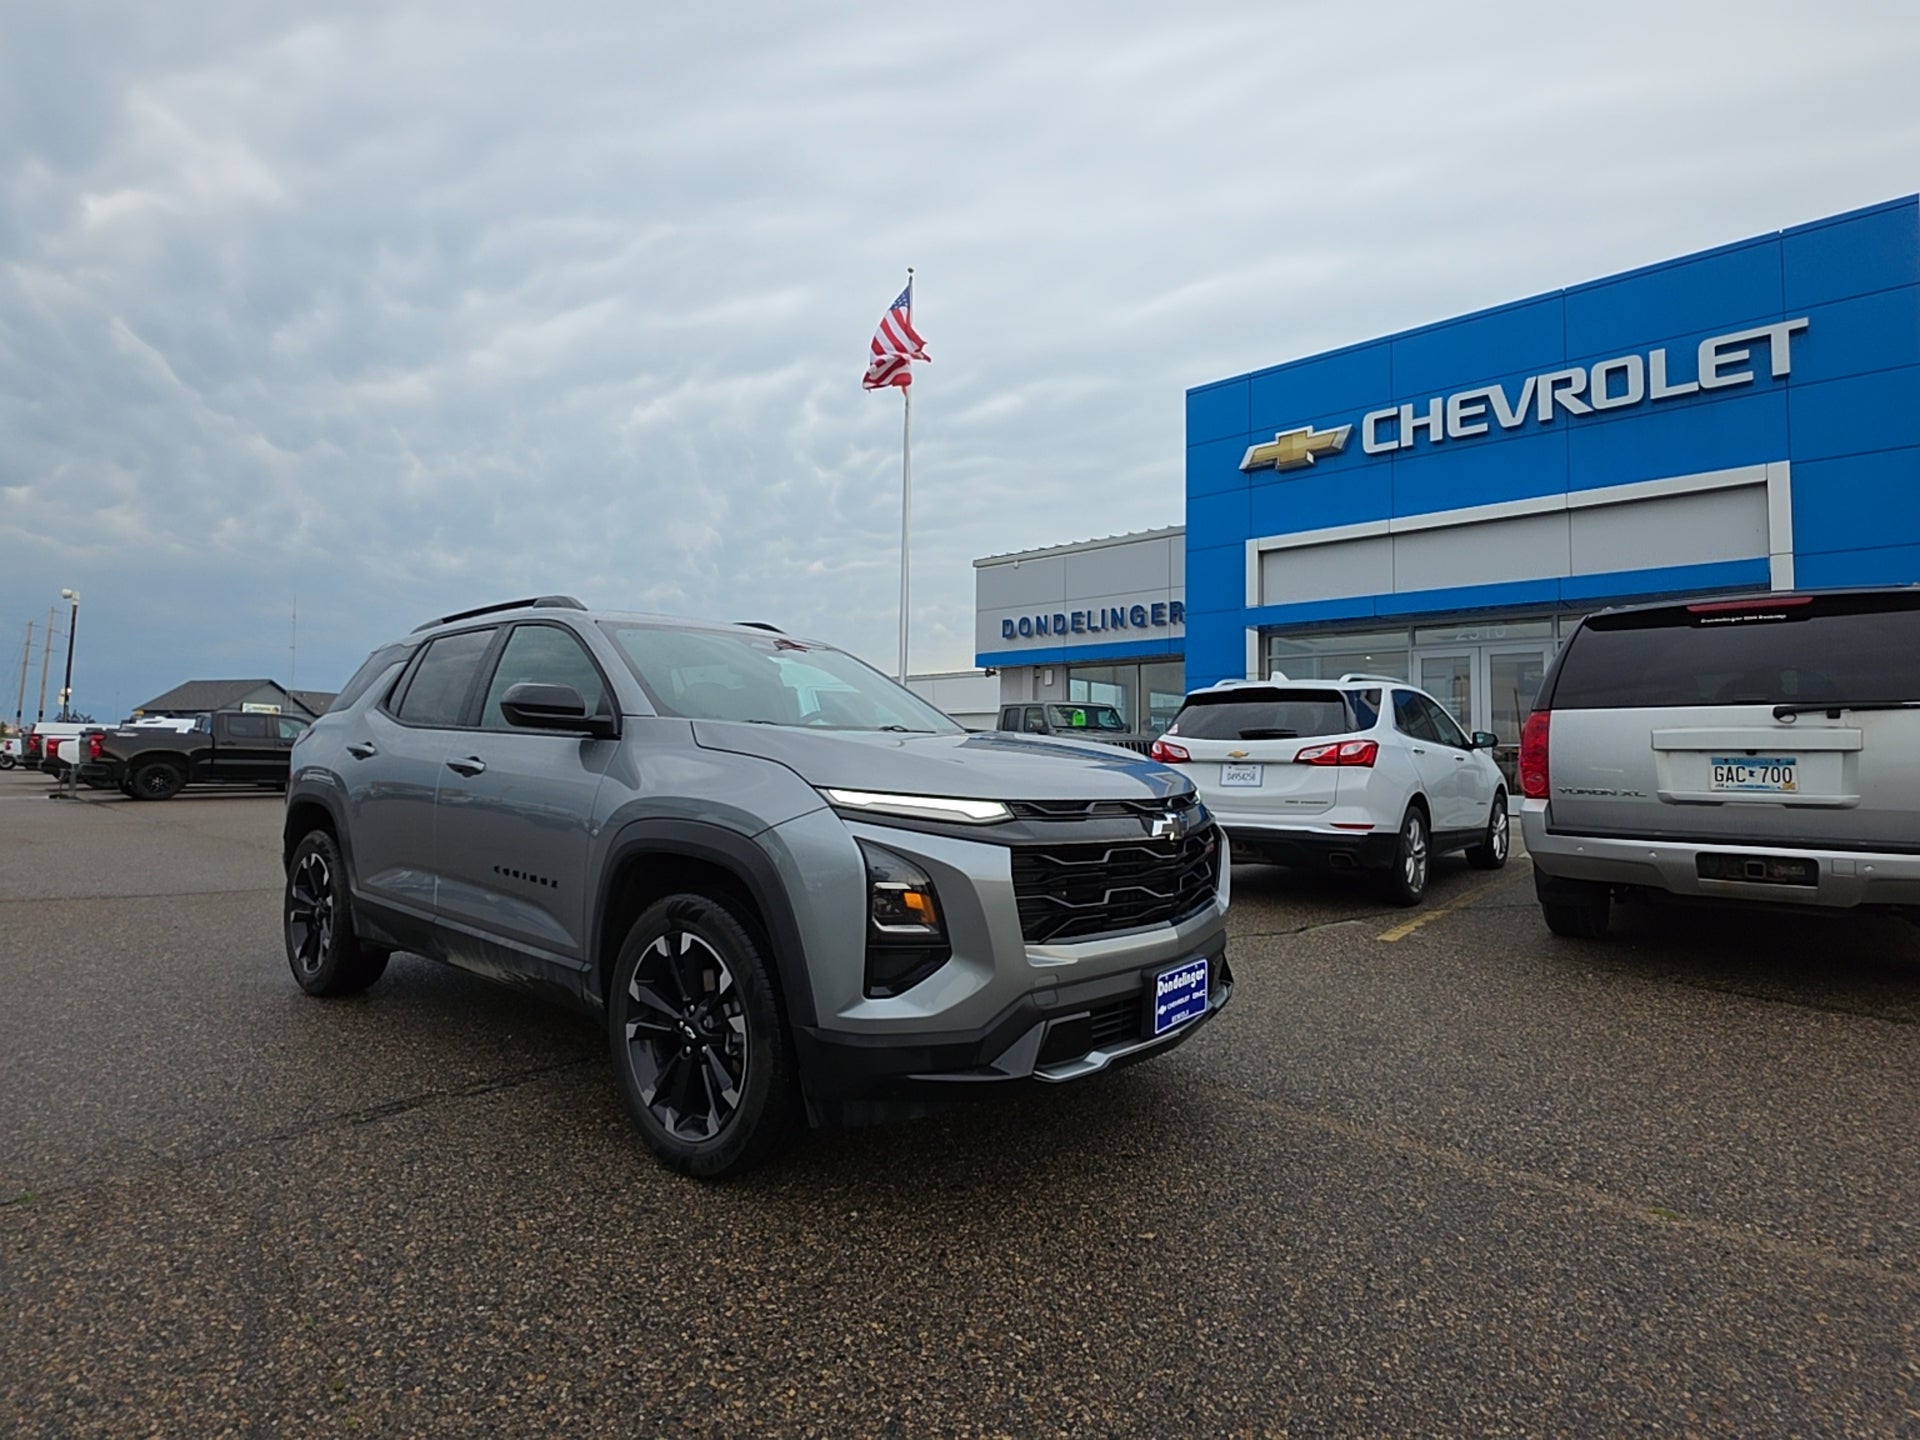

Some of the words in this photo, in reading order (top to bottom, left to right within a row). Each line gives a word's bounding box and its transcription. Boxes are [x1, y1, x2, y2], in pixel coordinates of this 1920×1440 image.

[1362, 317, 1809, 454] CHEVROLET
[1001, 600, 1186, 640] DONDELINGER
[1714, 765, 1746, 783] GAC
[1760, 766, 1793, 783] 700
[1557, 787, 1617, 797] YUKON
[1620, 790, 1648, 798] XL
[493, 865, 559, 889] EQUINOX
[1158, 969, 1205, 997] Dondelinger
